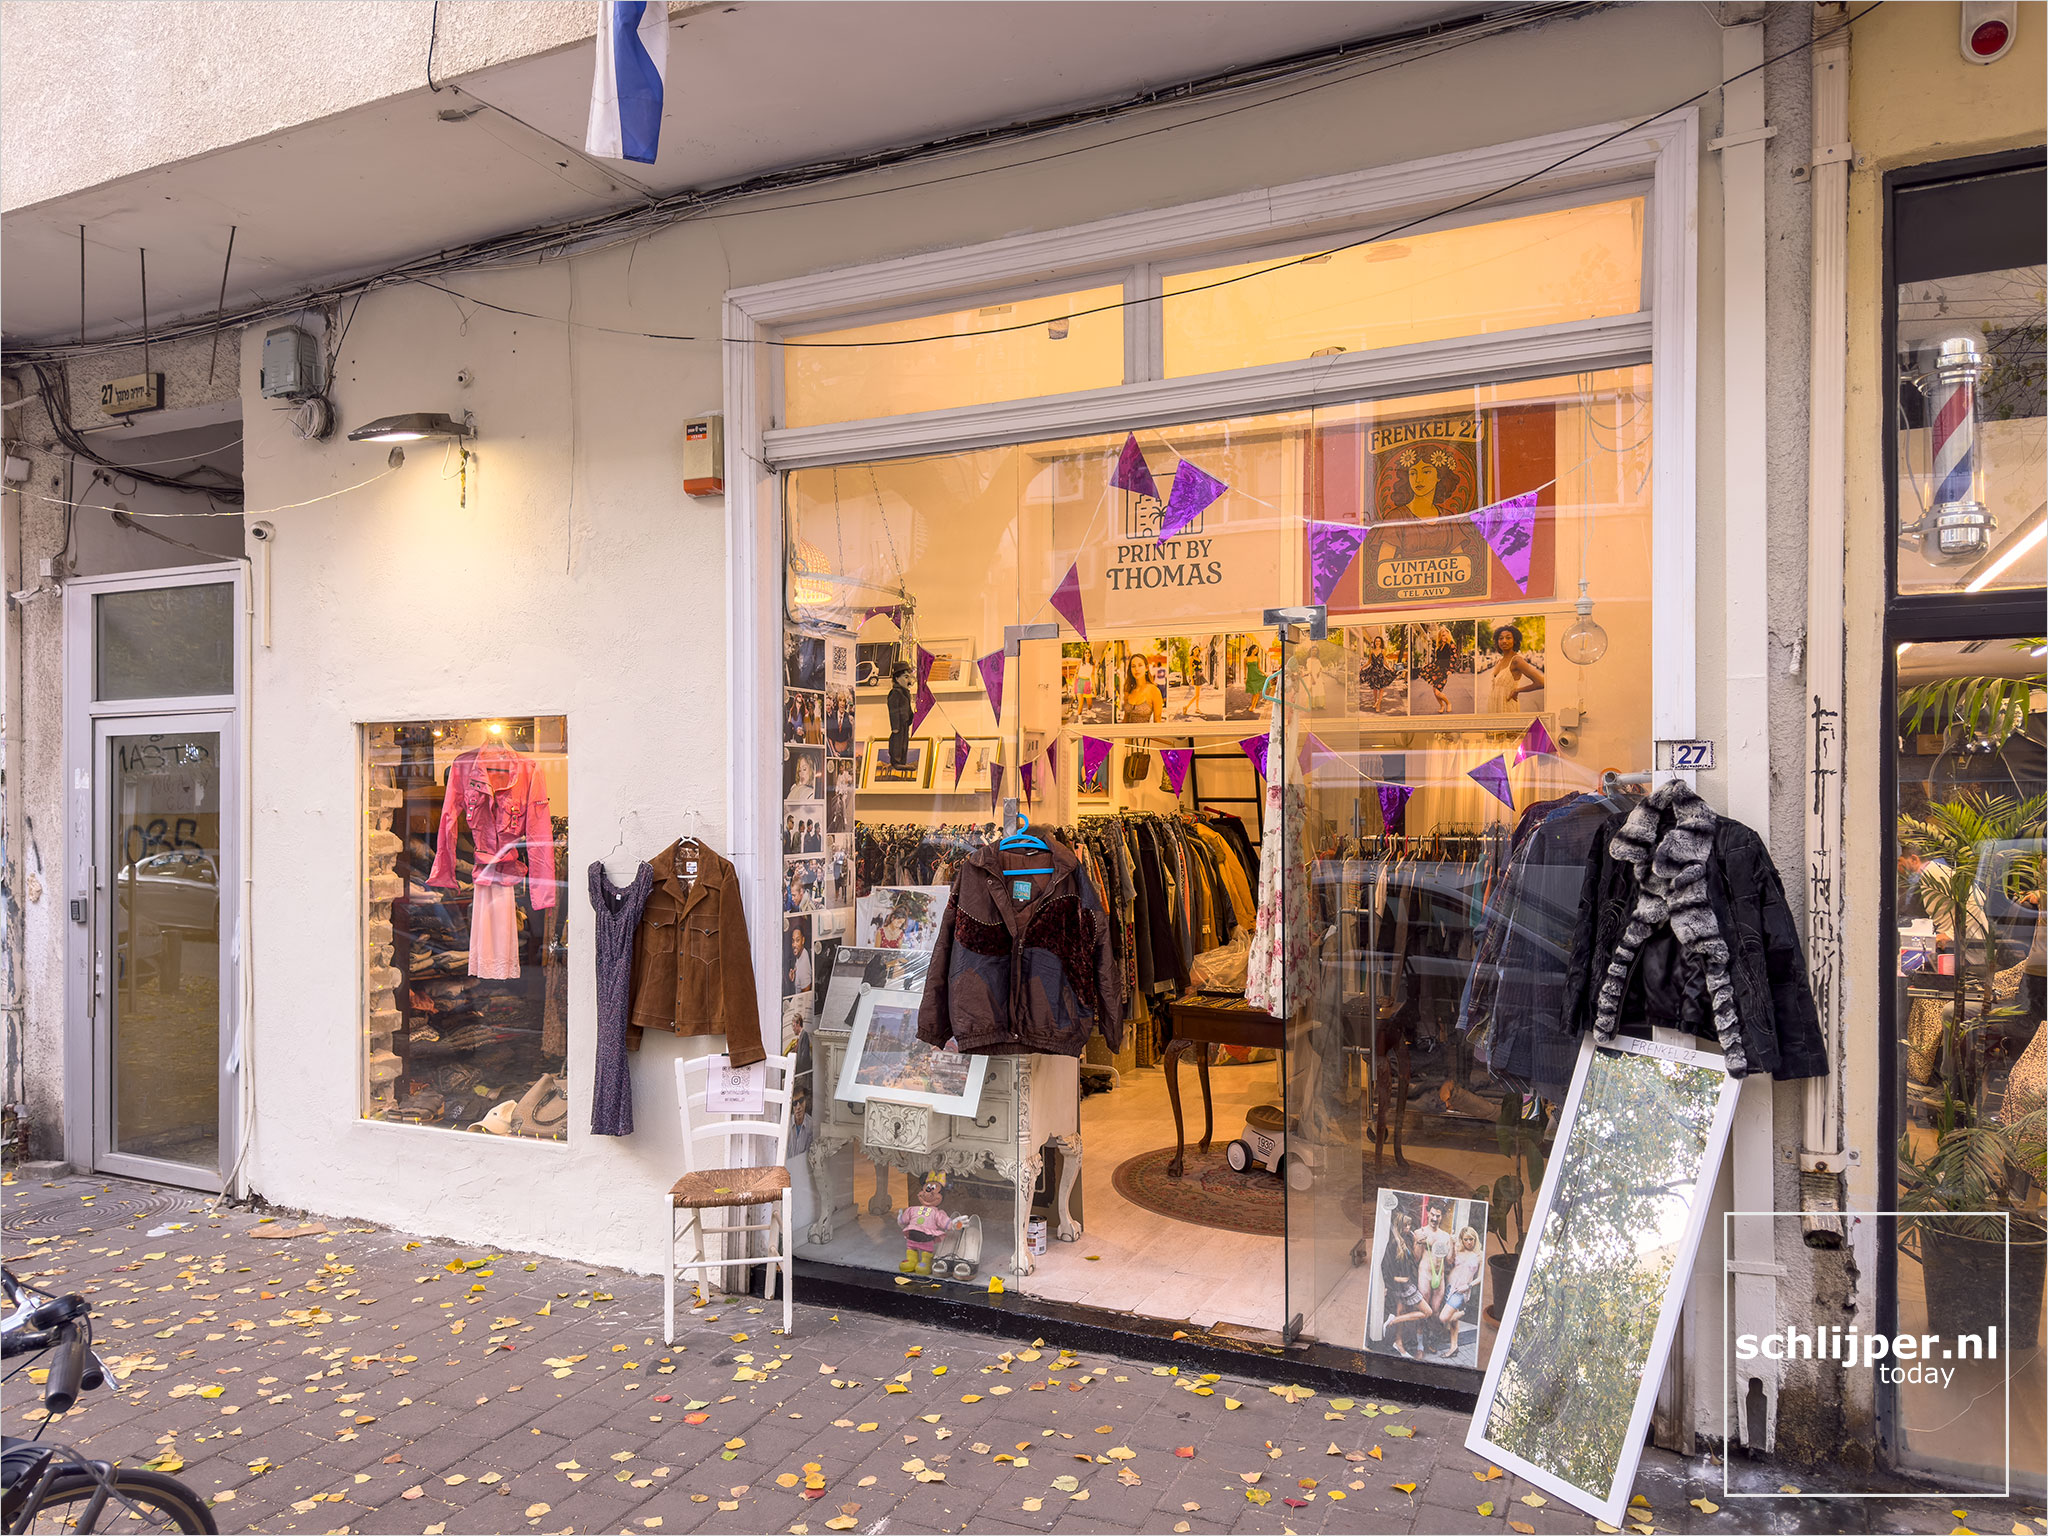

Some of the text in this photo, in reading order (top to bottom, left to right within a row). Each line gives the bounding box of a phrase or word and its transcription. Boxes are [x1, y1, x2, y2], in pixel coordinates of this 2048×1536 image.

[101, 383, 113, 405] 27
[1370, 419, 1483, 451] FRENKEL 27
[1117, 539, 1213, 564] PRINT BY
[1105, 561, 1223, 591] THOMAS
[1390, 558, 1459, 574] VINTAGE
[1383, 569, 1466, 587] CLOTHING
[1402, 587, 1445, 597] TEL AVIV
[1677, 745, 1707, 764] 27
[1631, 1039, 1697, 1061] FRENKEL 27
